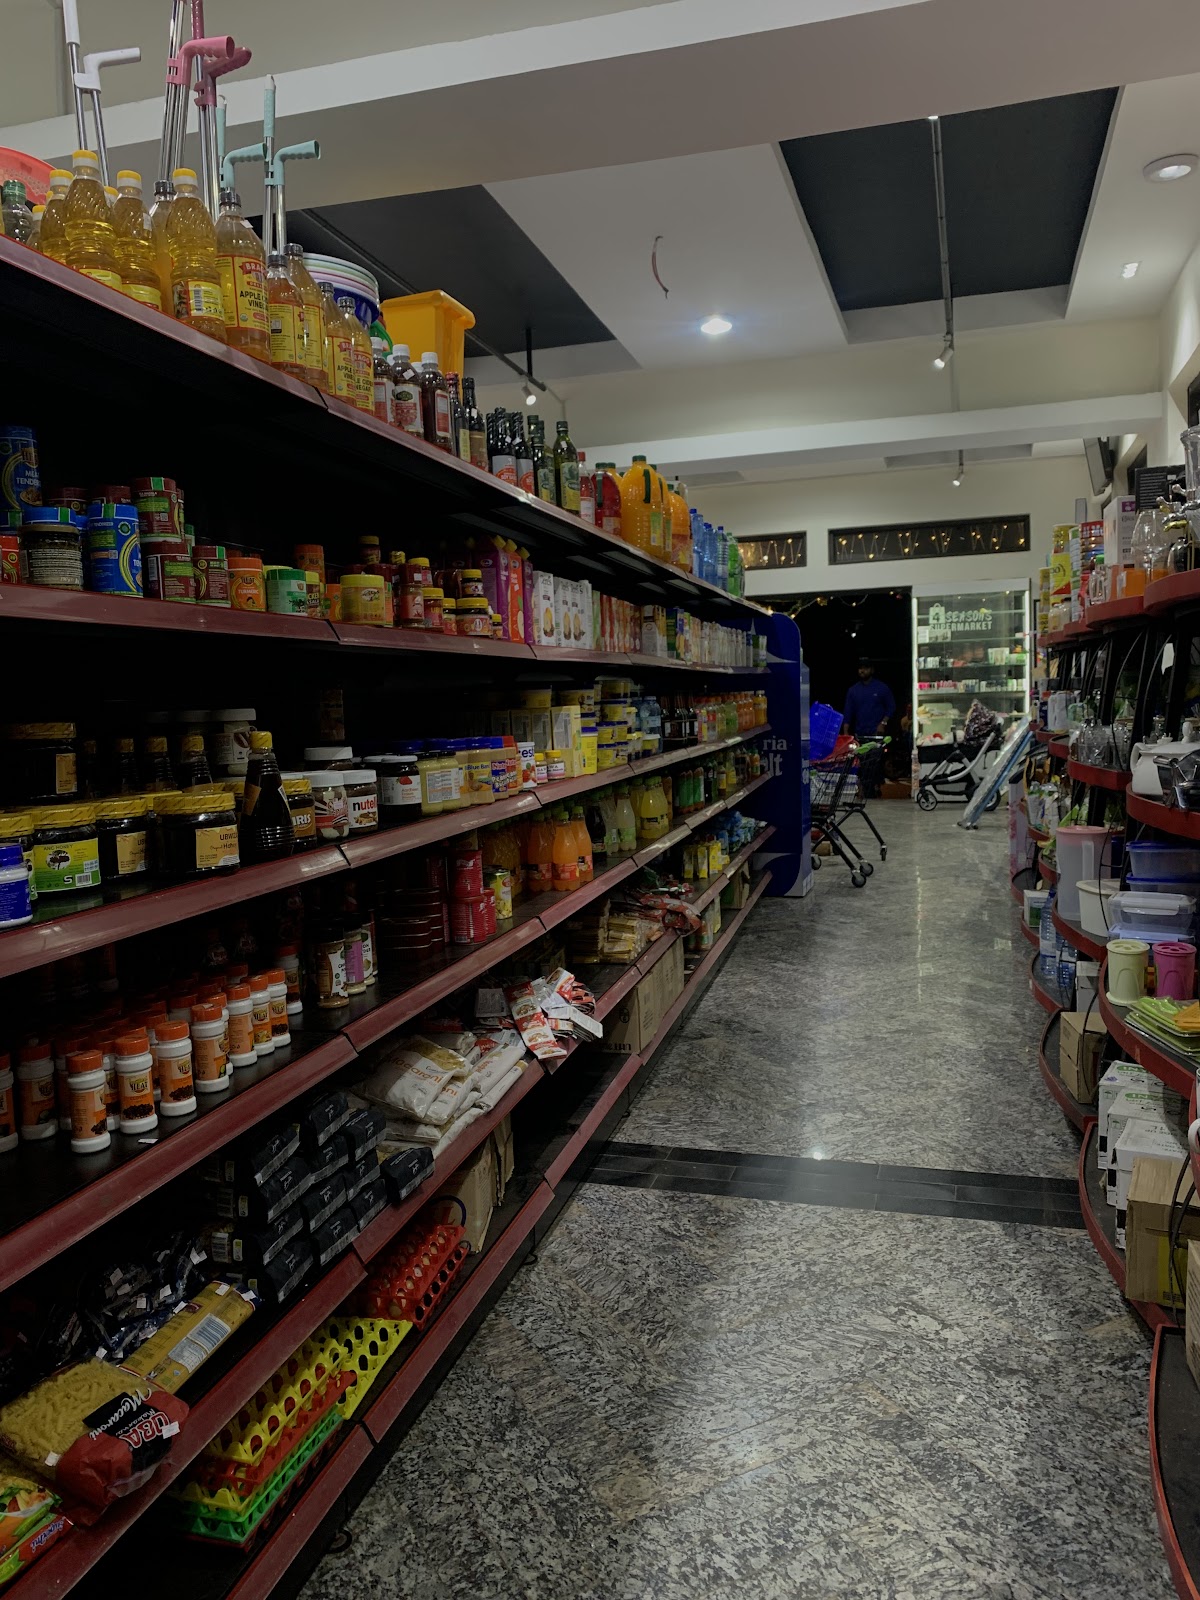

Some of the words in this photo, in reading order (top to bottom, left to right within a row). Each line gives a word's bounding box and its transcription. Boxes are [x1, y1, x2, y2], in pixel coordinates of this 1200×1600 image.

[240, 291, 262, 301] APPLE
[932, 612, 941, 622] 4
[945, 610, 993, 623] SEASONS
[930, 621, 993, 631] SUPERMARKET
[353, 796, 376, 812] nutel
[89, 1388, 152, 1441] Macaroni
